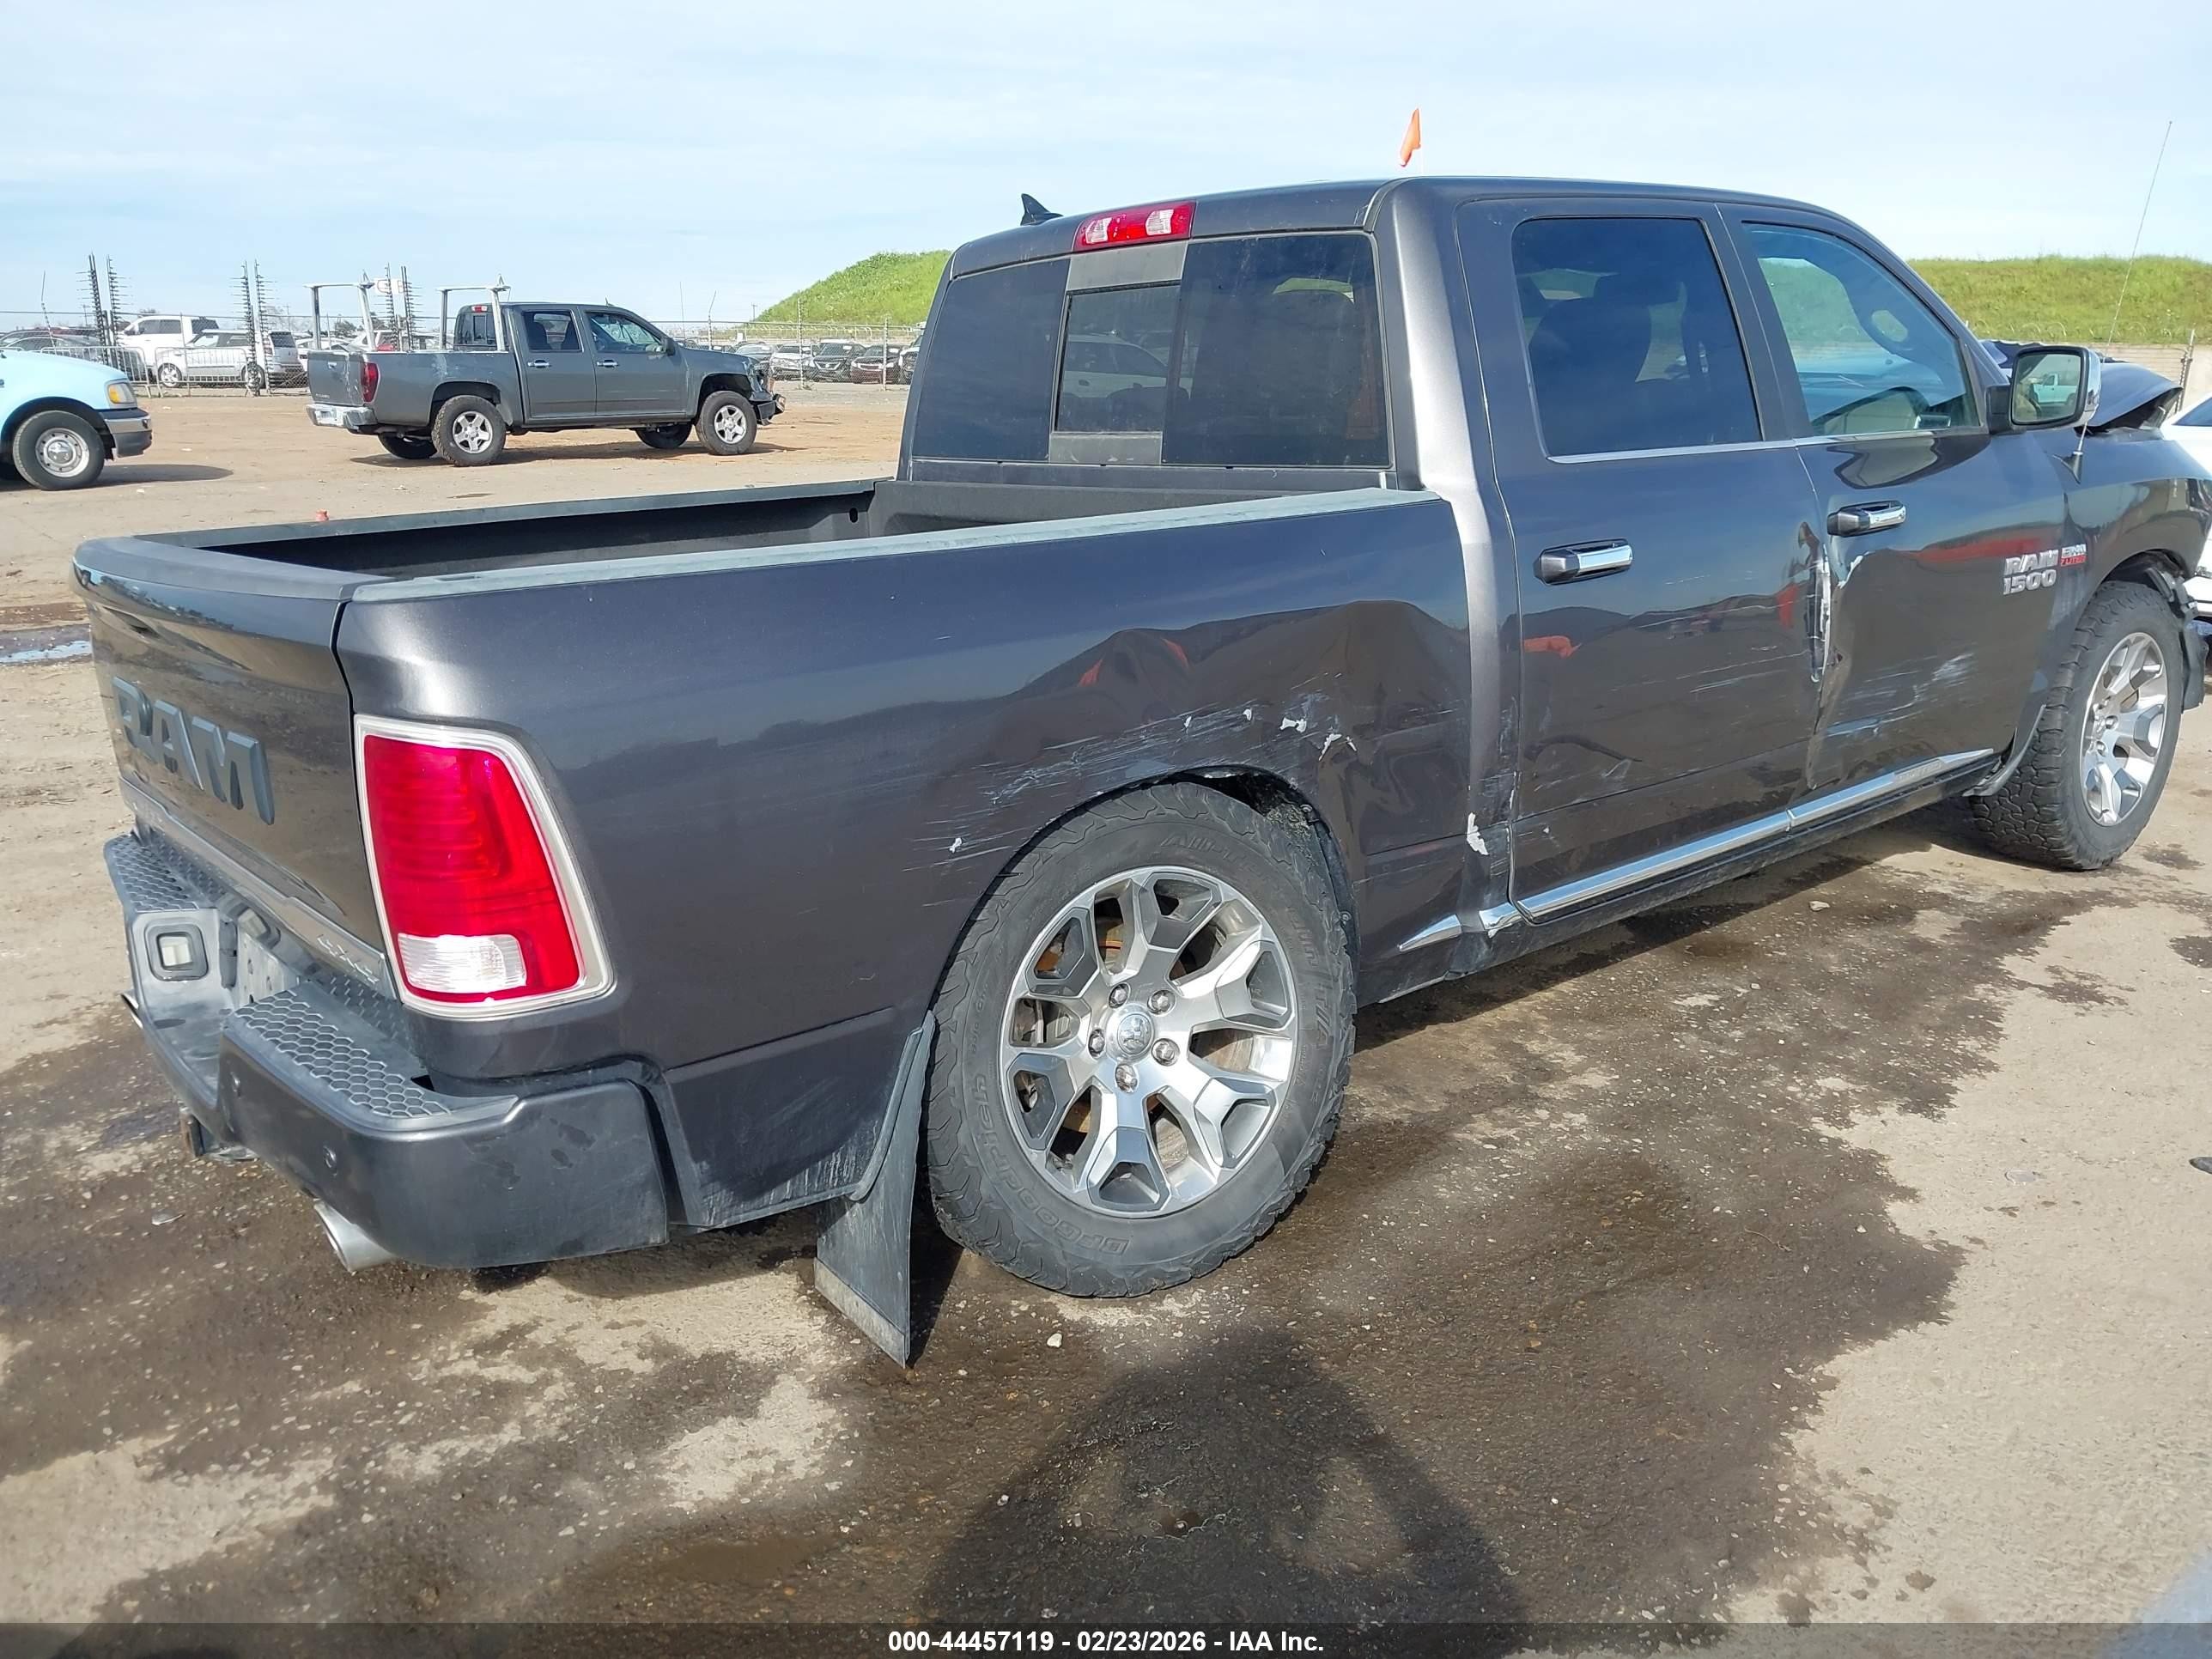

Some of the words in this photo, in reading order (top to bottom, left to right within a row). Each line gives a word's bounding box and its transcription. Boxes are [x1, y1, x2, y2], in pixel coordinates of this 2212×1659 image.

[2004, 550, 2059, 575] RAM
[2003, 568, 2057, 595] 1500
[112, 676, 275, 825] RAM
